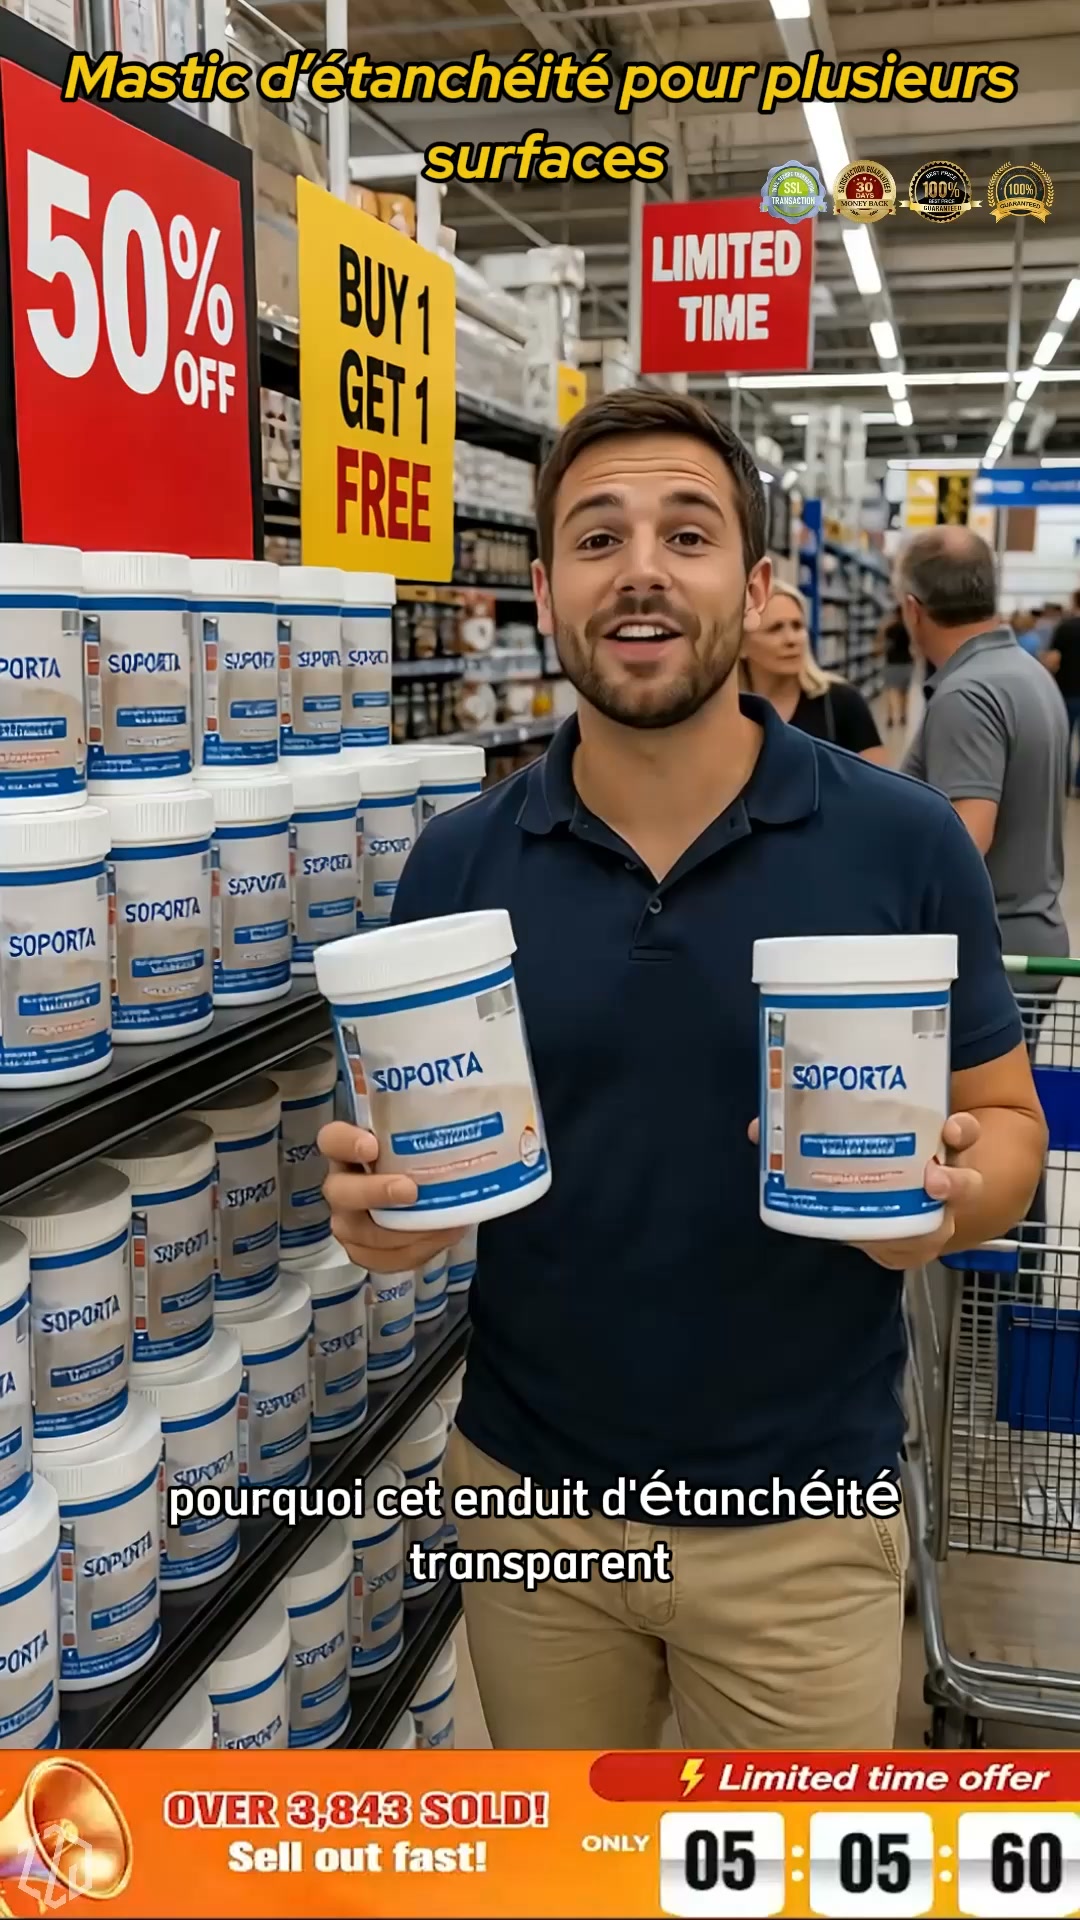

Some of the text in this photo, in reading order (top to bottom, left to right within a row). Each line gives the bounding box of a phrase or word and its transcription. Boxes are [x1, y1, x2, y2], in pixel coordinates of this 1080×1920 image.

[26, 149, 235, 395] 50%
[651, 229, 803, 283] LIMITED
[339, 243, 430, 356] BUY 1
[678, 293, 770, 342] TIME
[173, 350, 236, 414] OFF
[339, 348, 429, 445] GET 1
[336, 444, 431, 544] FREE
[9, 926, 96, 958] SOPORTA
[372, 1050, 484, 1094] SOPORTA
[791, 1064, 908, 1091] SOPORTA
